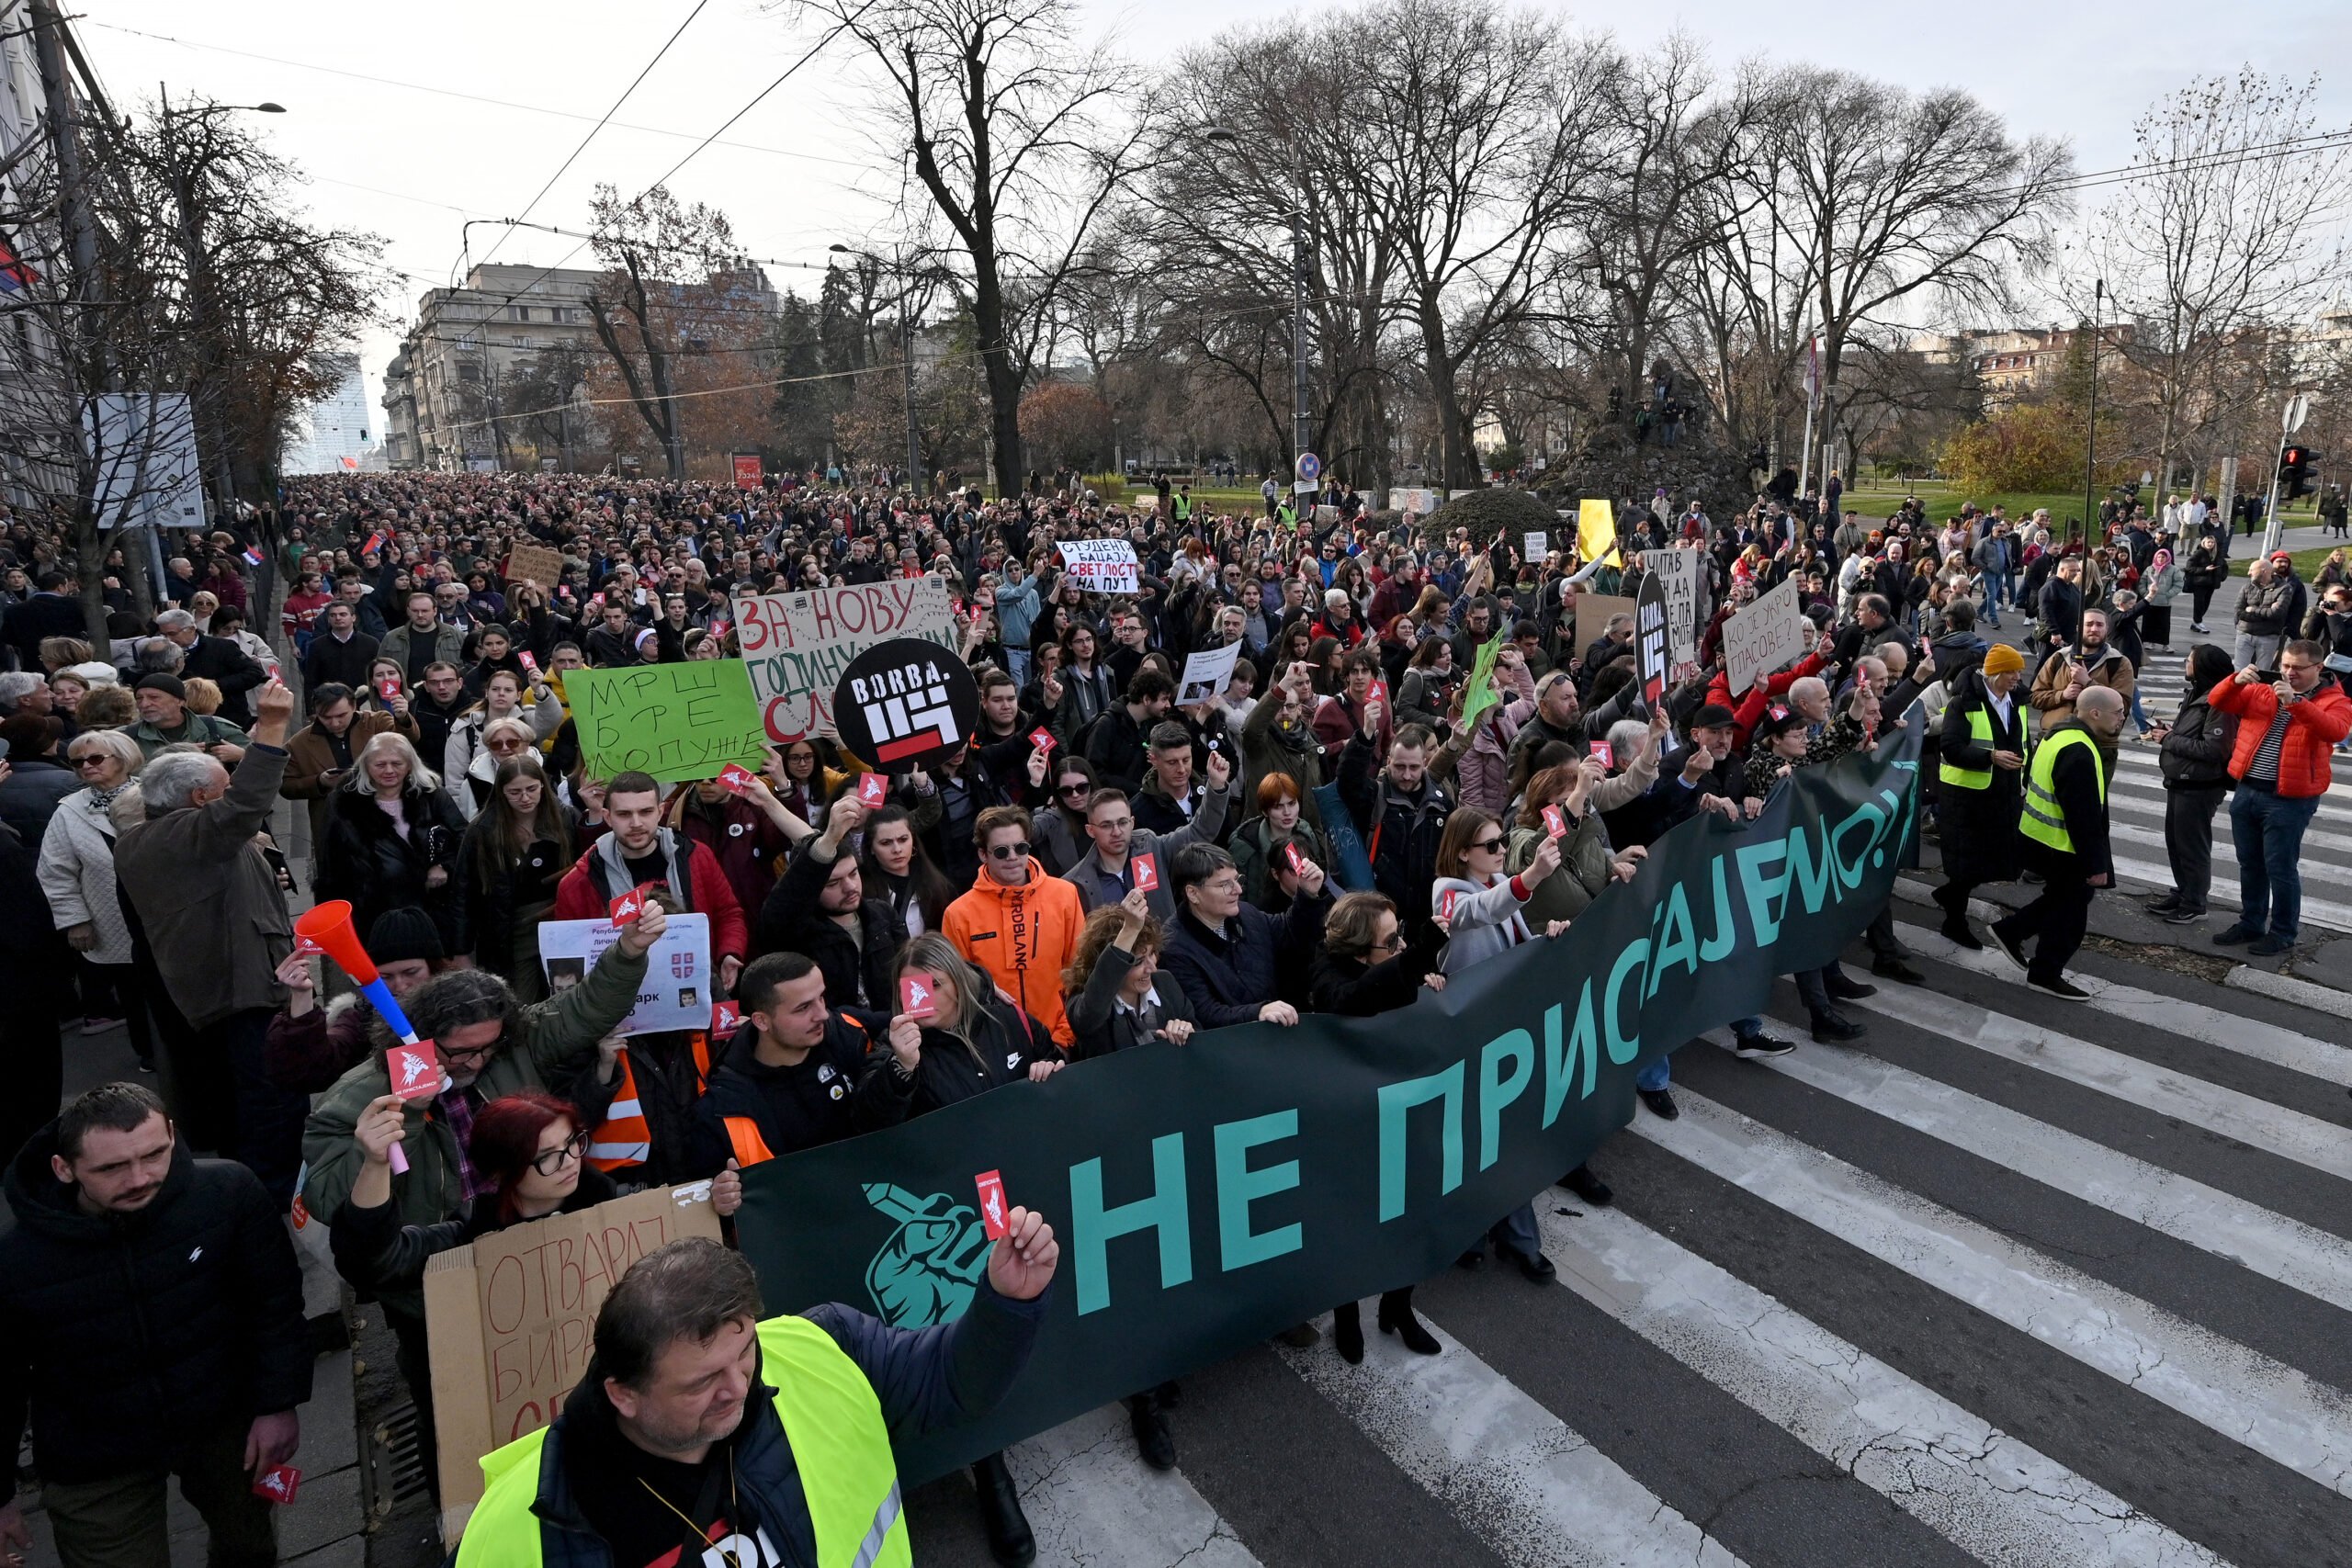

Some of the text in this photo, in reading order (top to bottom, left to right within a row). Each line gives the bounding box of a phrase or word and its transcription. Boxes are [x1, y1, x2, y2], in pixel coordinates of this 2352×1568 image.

[1069, 562, 1136, 576] СВЕТЛОСТ
[1079, 552, 1128, 562] БАЦАЈУ
[1076, 577, 1129, 590] НА ПУТ
[1673, 577, 1690, 600] ДА
[741, 599, 795, 650] ЗА
[811, 583, 915, 640] НОВУ
[1679, 602, 1691, 626] ПА
[1727, 623, 1745, 651] КО
[1731, 617, 1792, 678] ГЛАСОВЕ?
[591, 667, 717, 716] МРШ
[851, 660, 951, 705] BORBA.
[597, 694, 724, 748] БРЕ
[636, 993, 660, 1004] арк
[1069, 1108, 1303, 1316] НЕ
